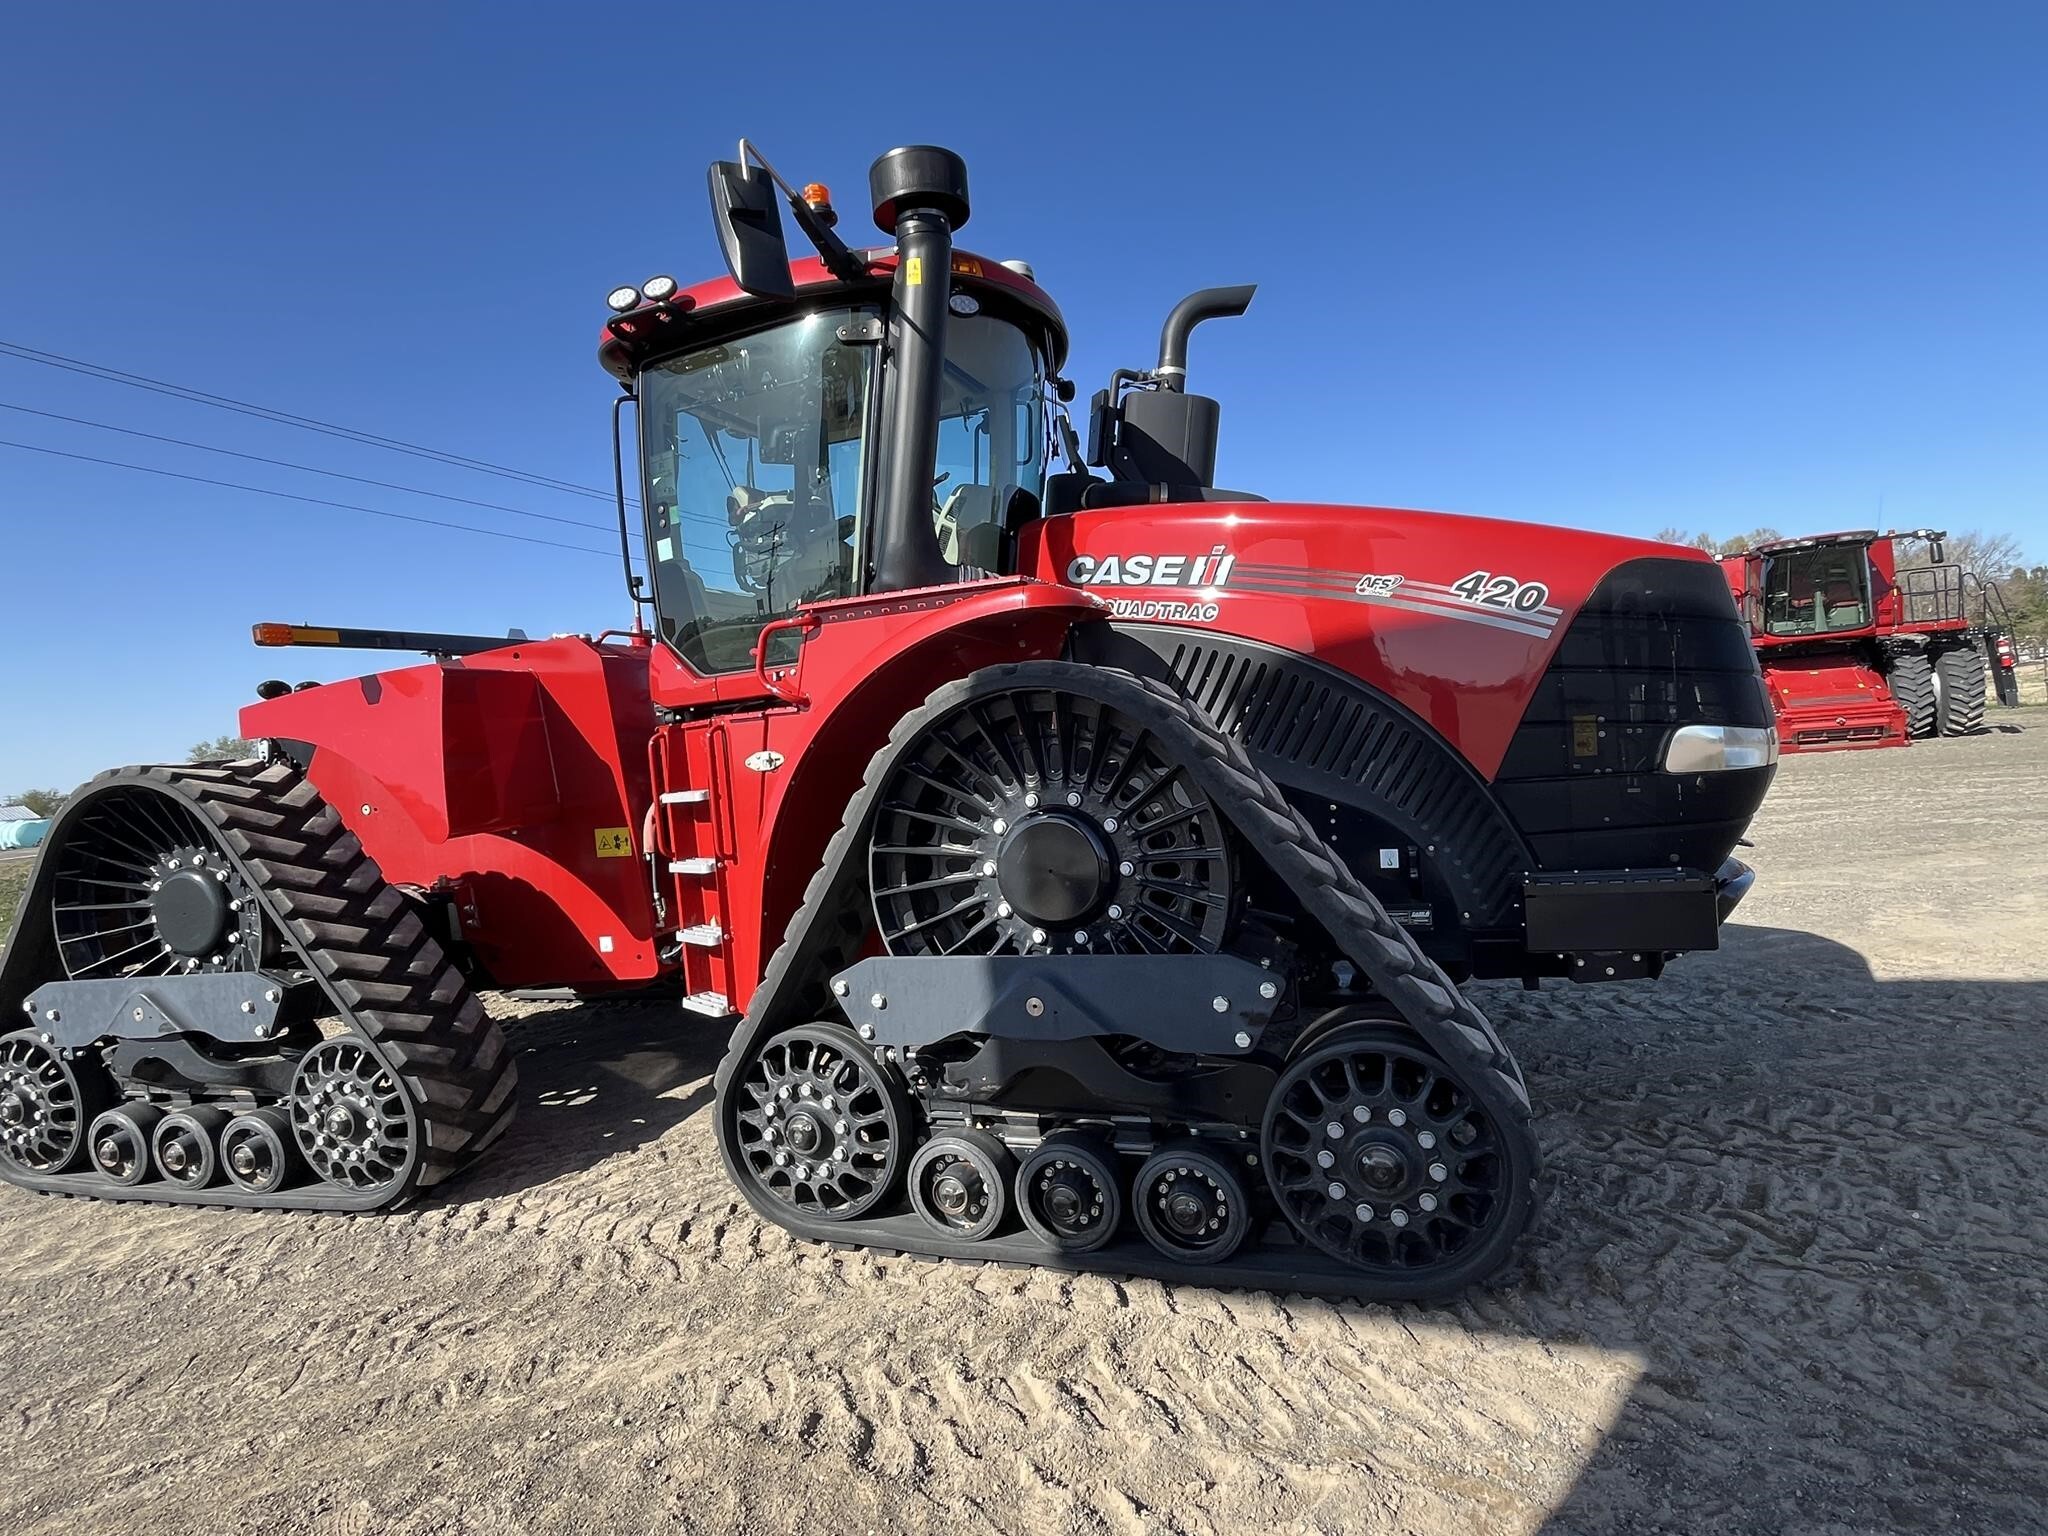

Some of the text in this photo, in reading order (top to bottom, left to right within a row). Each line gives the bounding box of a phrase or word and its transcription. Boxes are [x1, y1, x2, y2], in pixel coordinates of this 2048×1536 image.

[1067, 555, 1188, 585] CASE
[1357, 575, 1393, 590] AFS
[1450, 571, 1548, 614] 420
